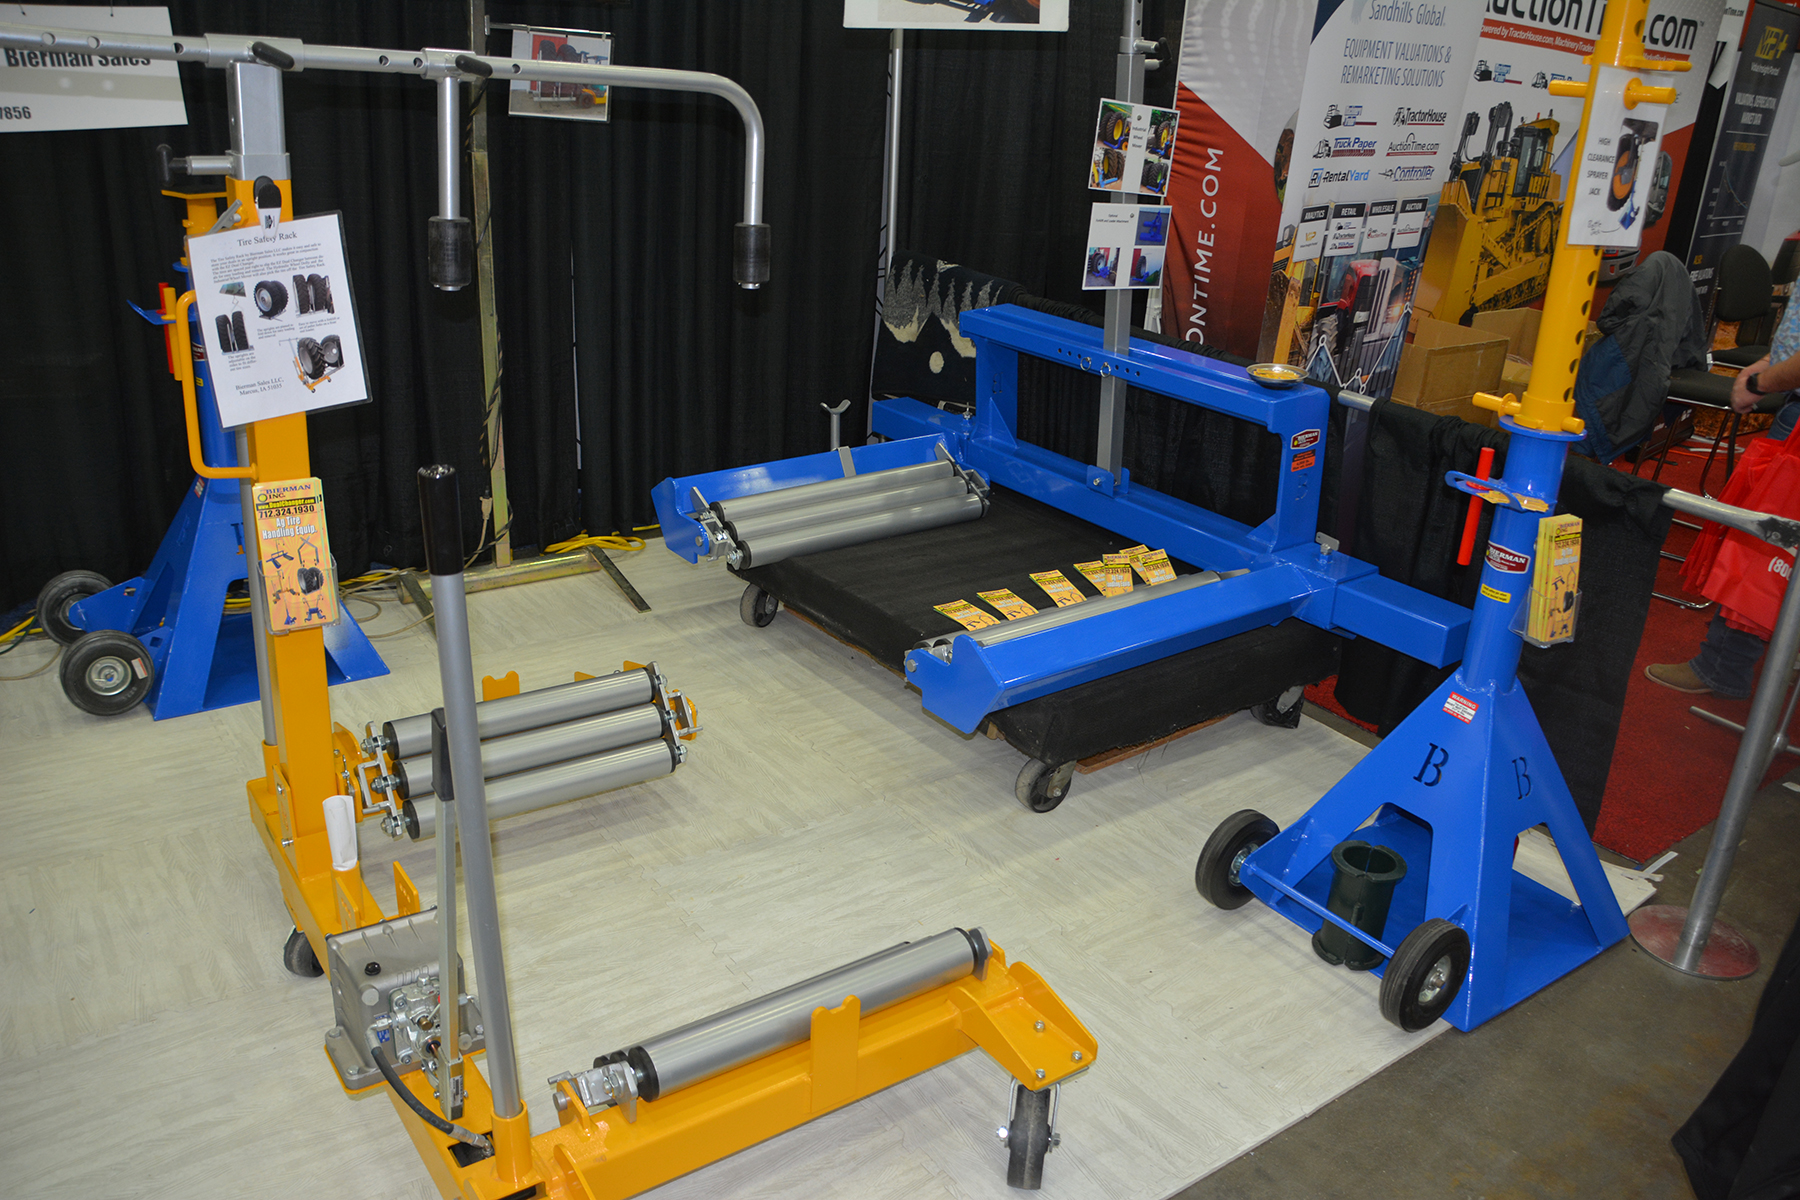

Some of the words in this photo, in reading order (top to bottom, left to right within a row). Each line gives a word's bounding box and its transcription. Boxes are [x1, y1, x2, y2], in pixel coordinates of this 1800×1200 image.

[1369, 0, 1414, 24] Sandhills
[1480, 24, 1501, 35] owered
[1501, 28, 1508, 38] by
[1508, 28, 1554, 46] TractorHouse.com,
[4, 47, 94, 68] Bierman
[1344, 38, 1394, 60] EQUIPMENT
[1394, 42, 1443, 64] VALUATIONS
[1443, 46, 1451, 63] &
[1340, 65, 1401, 86] REMARKETING
[1401, 69, 1445, 88] SOLUTIONS
[1406, 107, 1447, 123] TractorHouse
[1388, 138, 1440, 152] AuctionTime.com
[1598, 137, 1611, 146] HIGH
[1587, 153, 1616, 164] CLEARANCE
[1322, 170, 1370, 183] RentalYard
[1393, 165, 1435, 179] Controller
[1587, 170, 1608, 180] SPRAYER
[1589, 187, 1601, 196] JACK
[1341, 207, 1357, 216] RETAIL
[1371, 204, 1394, 214] WHOLESALE
[1405, 202, 1422, 211] AUCTION
[1304, 209, 1325, 220] ANALYTICS
[237, 238, 252, 247] Tire
[278, 231, 298, 241] Rack
[266, 484, 311, 494] BIERMAN
[258, 498, 315, 510] www.DualChanger.com
[258, 505, 315, 519] 712.324.1930
[276, 517, 286, 528] Ag
[286, 515, 301, 526] Tire
[262, 527, 295, 540] Handling
[295, 524, 318, 535] Equip.
[1490, 546, 1526, 564] BIERMAN
[1451, 693, 1477, 710] WARNING
[1412, 742, 1449, 788] B
[1511, 756, 1532, 800] B
